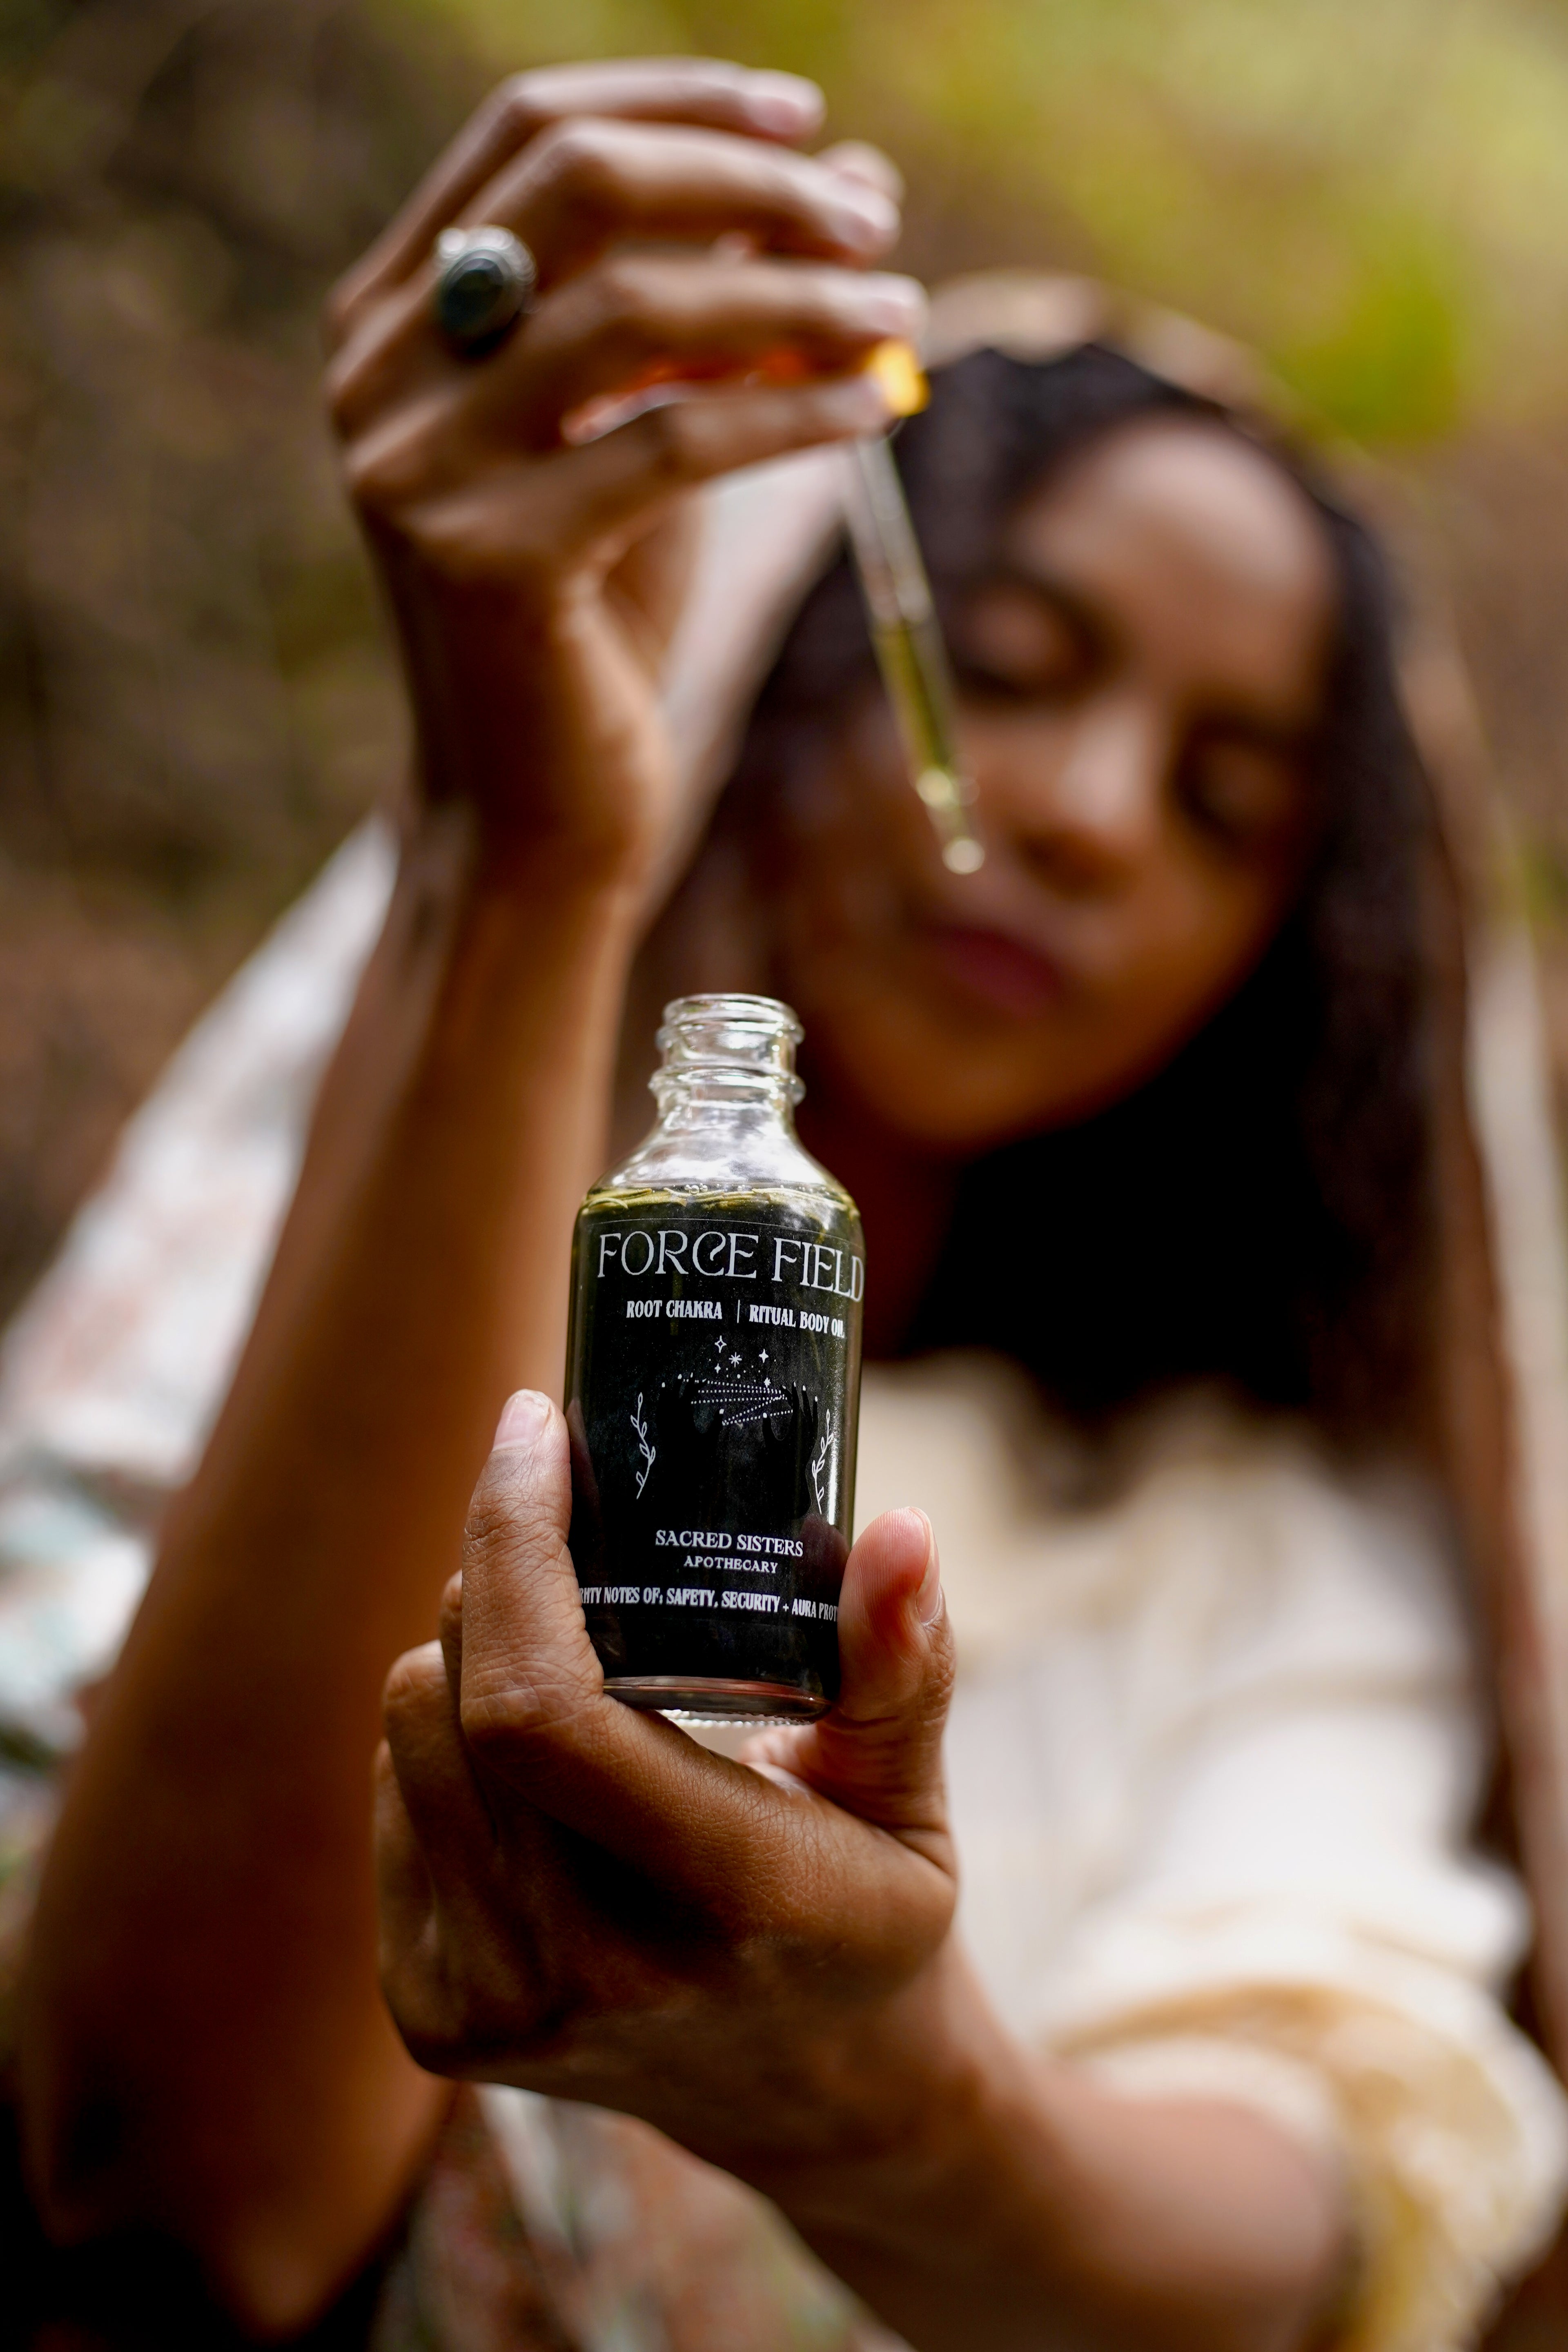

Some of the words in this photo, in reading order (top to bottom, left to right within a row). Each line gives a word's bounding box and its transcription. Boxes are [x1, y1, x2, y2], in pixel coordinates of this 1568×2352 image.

[597, 1230, 759, 1278] FORCE
[771, 1237, 864, 1302] FIELD
[626, 1300, 662, 1318] ROOT
[666, 1300, 722, 1319] CHAKRA
[749, 1304, 796, 1327] RITUAL
[800, 1311, 829, 1334] BODY
[831, 1318, 845, 1339] OIL
[655, 1530, 732, 1549] SACRED
[736, 1534, 803, 1557] SISTERS
[683, 1555, 778, 1573] APOTHECARY
[604, 1587, 640, 1604] NOTES
[643, 1587, 663, 1605] OF:
[666, 1588, 719, 1608] SAFETY,
[721, 1591, 781, 1613] SECURITY
[791, 1598, 817, 1618] AURA
